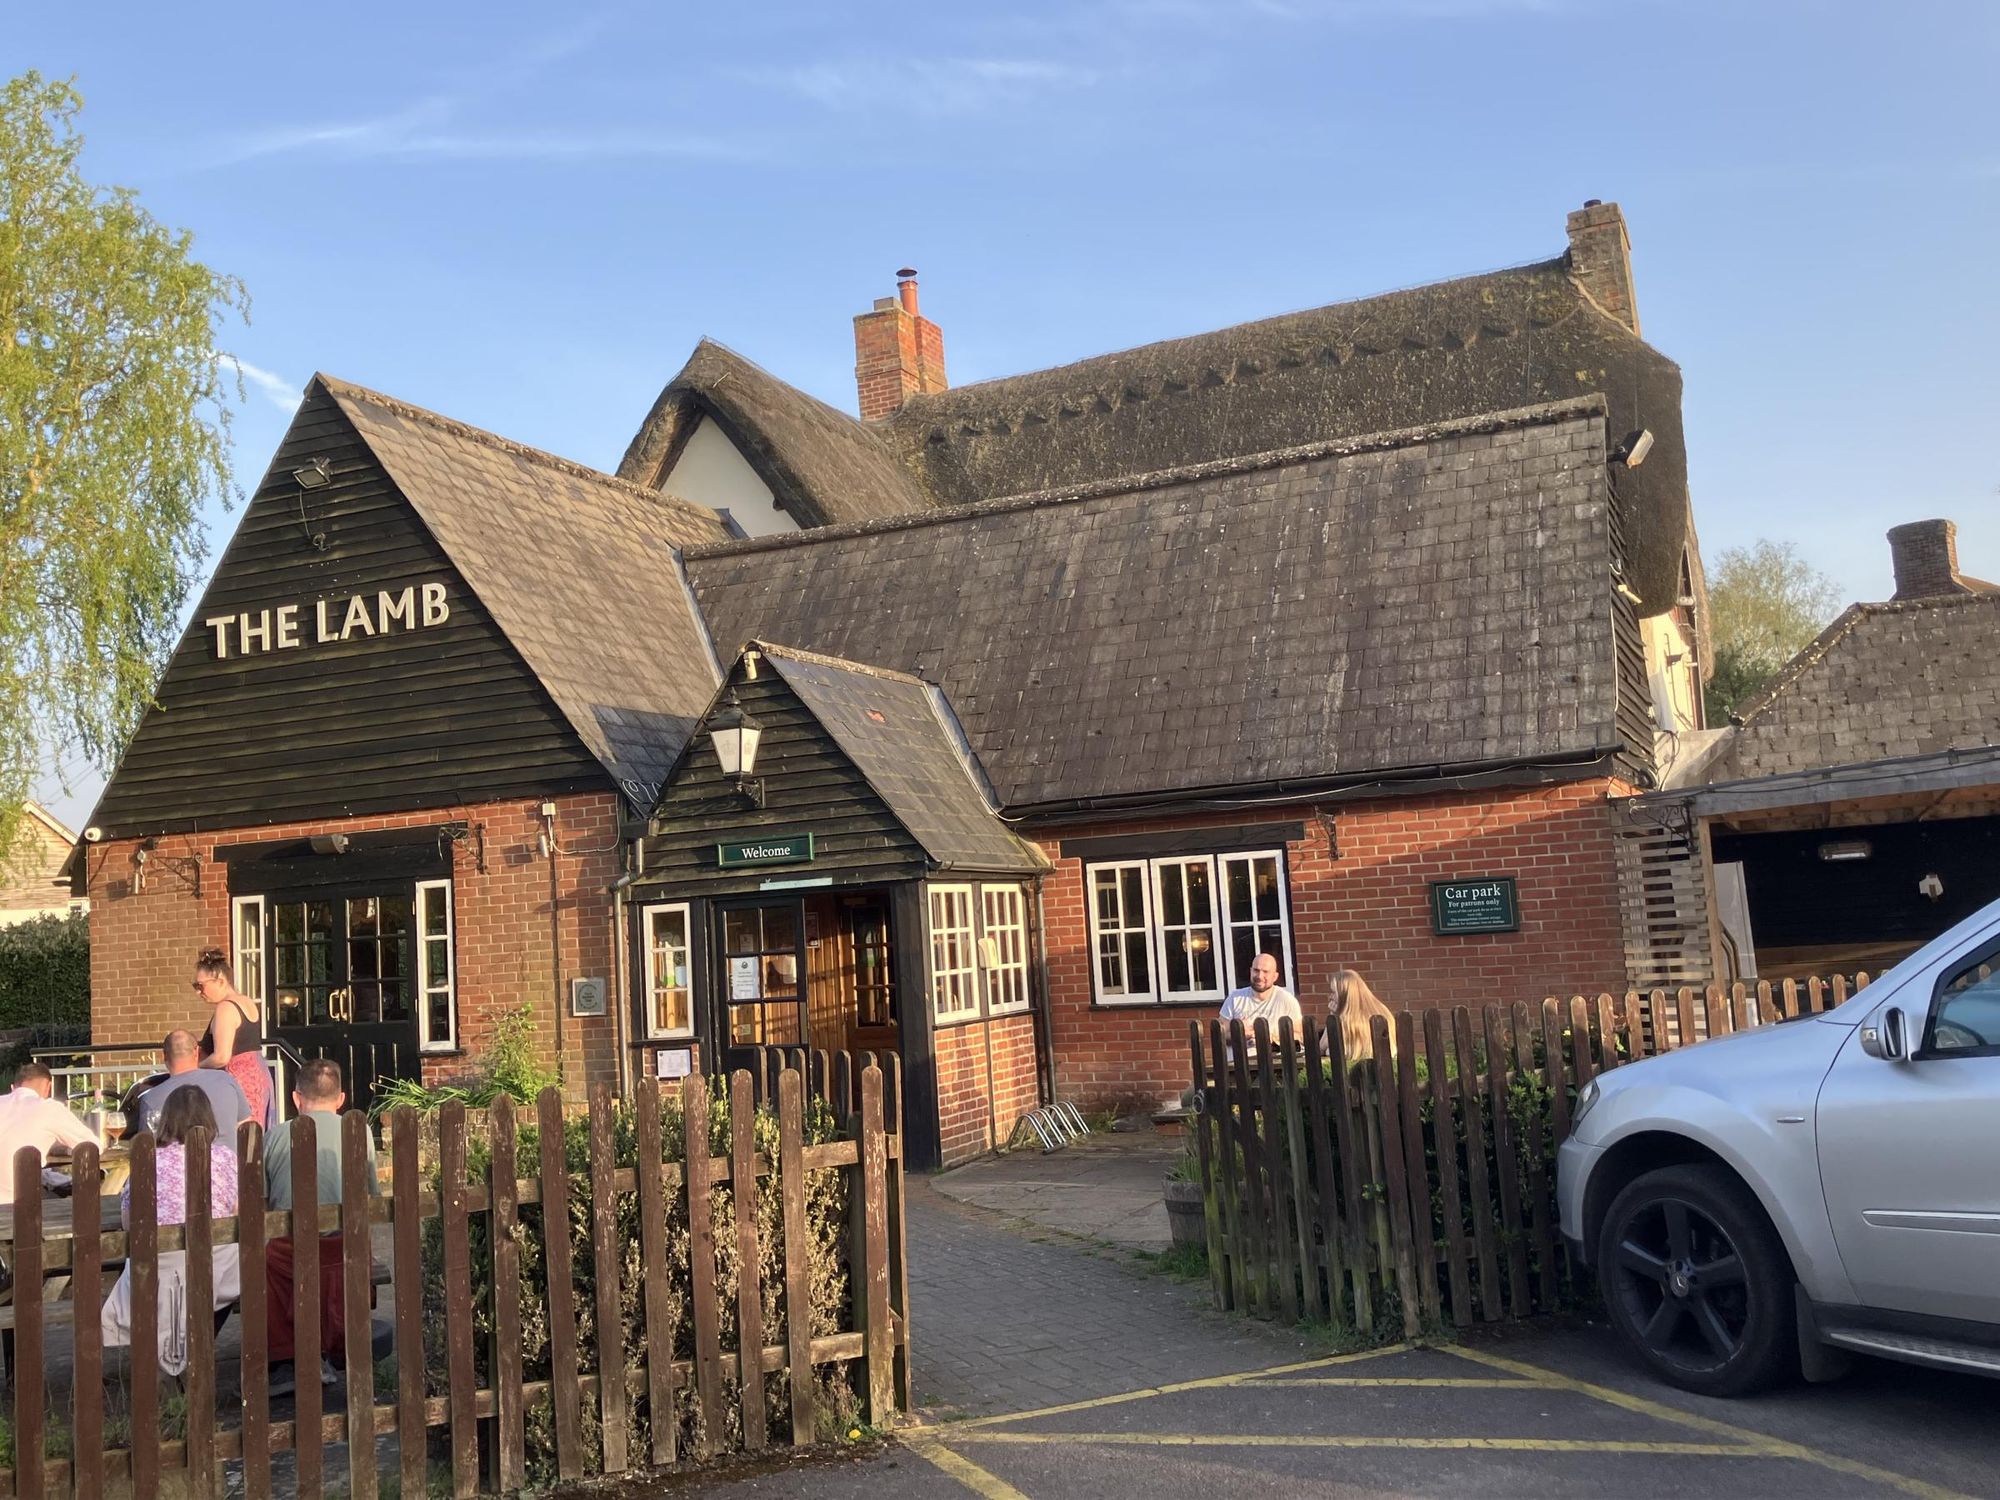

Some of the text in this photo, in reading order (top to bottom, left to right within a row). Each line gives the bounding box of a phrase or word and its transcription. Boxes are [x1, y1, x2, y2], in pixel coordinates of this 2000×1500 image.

[206, 582, 450, 658] THE LAMB
[742, 846, 790, 858] Welcome
[1445, 884, 1501, 900] Car park
